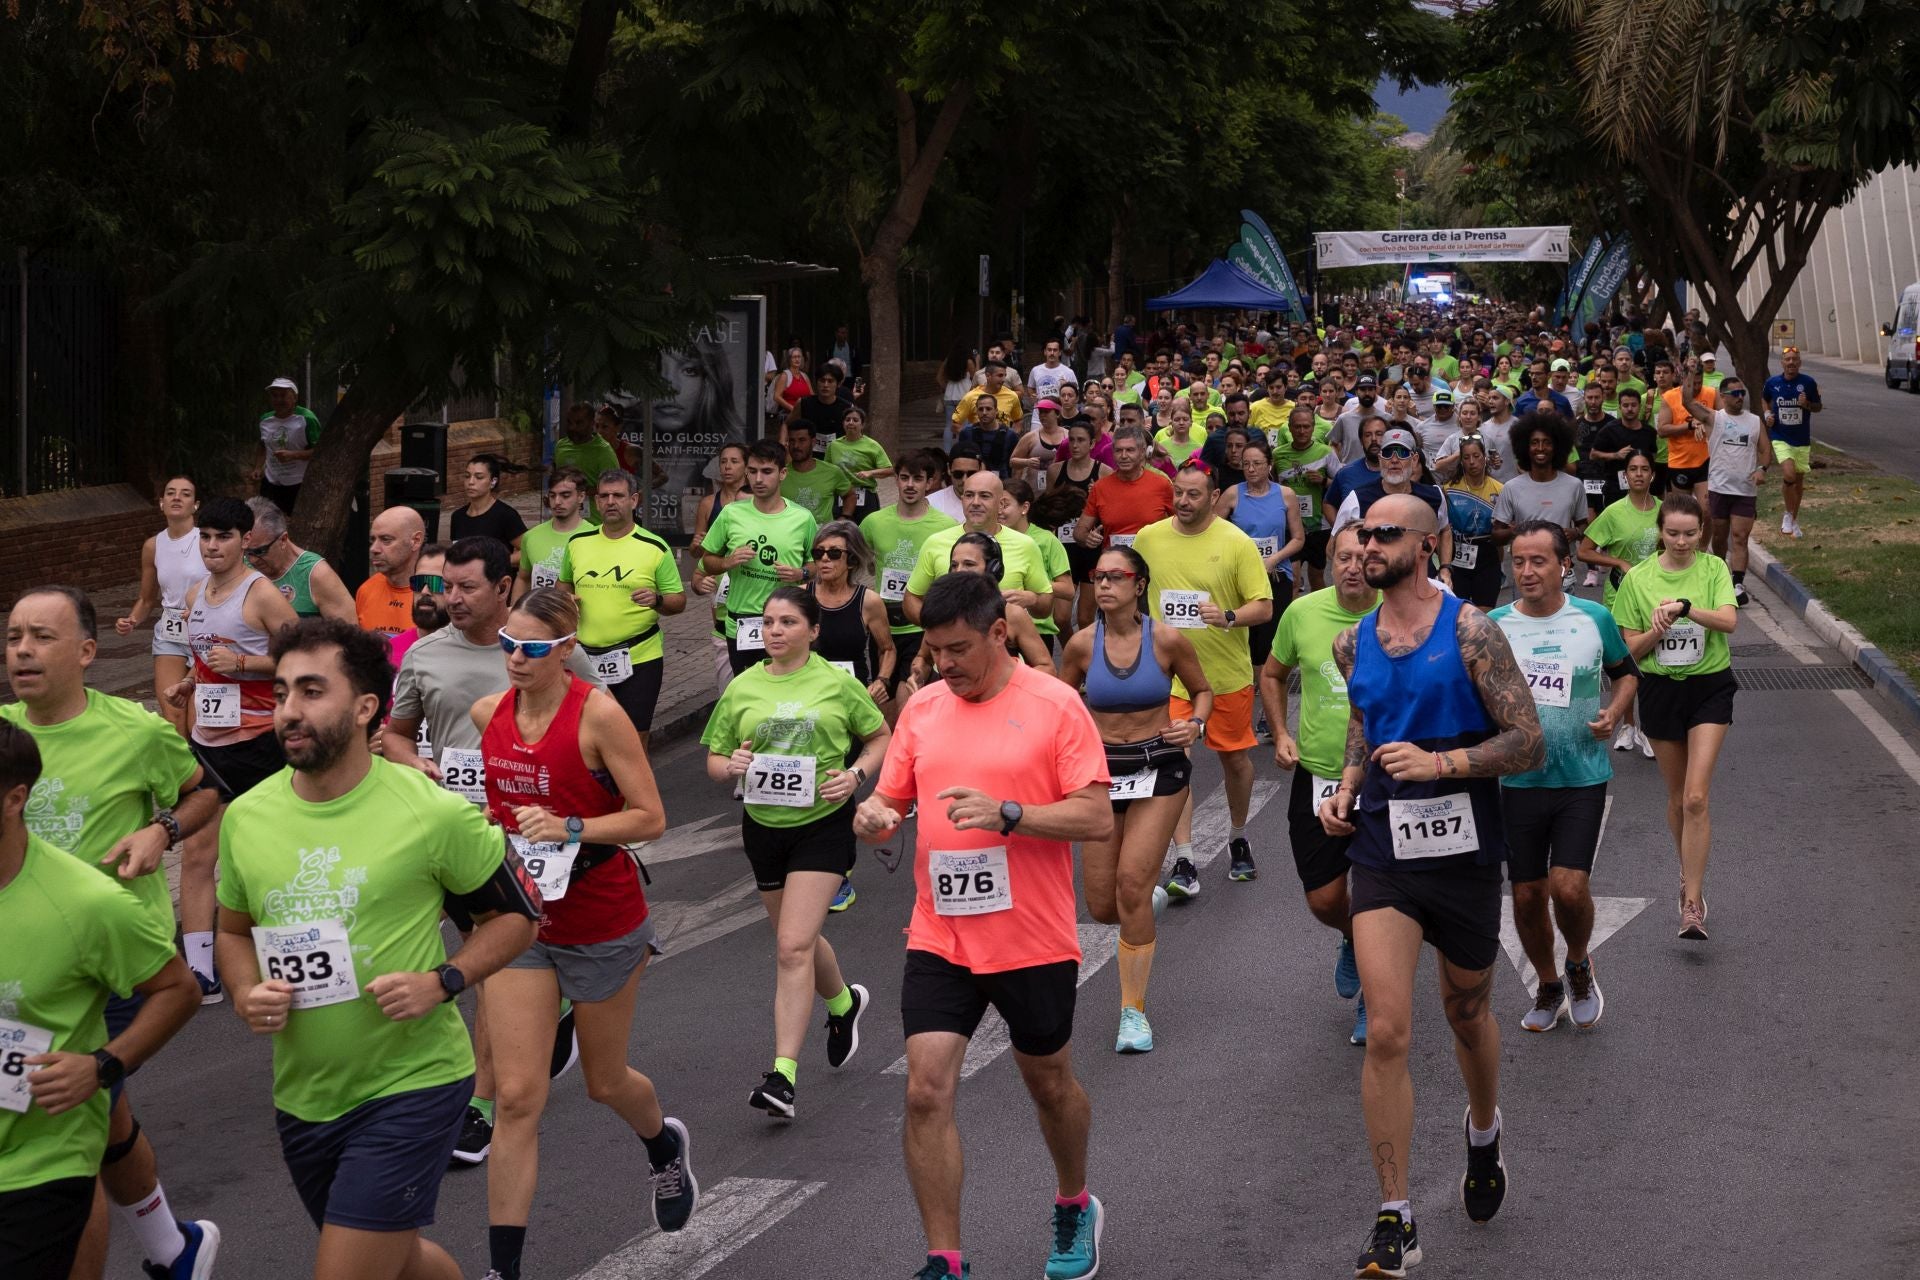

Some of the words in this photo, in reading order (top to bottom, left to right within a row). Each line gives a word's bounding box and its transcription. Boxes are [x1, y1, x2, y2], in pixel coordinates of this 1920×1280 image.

[1381, 233, 1428, 243] Carrera
[1431, 231, 1447, 241] de
[1450, 231, 1461, 241] la
[1465, 231, 1507, 240] Prensa
[1576, 238, 1602, 289] Fundació
[1591, 243, 1625, 295] Fundació
[1599, 258, 1629, 299] Unicaja
[616, 432, 673, 443] ABELO
[676, 432, 728, 443] GLOSSY
[657, 446, 717, 455] ANTI-FRIZZ
[761, 549, 777, 561] BM
[1165, 603, 1199, 617] 936
[166, 619, 182, 633] 21
[1658, 638, 1698, 651] 1071
[597, 662, 618, 675] 42
[1527, 673, 1564, 691] 744
[202, 698, 222, 714] 37
[498, 758, 536, 774] GENERALI
[496, 777, 539, 795] MÁLAGA
[755, 771, 802, 792] 782
[1398, 815, 1462, 840] 1187
[938, 871, 994, 896] 876
[264, 888, 342, 913] Carrera
[267, 950, 333, 984] 633
[0, 1048, 27, 1077] 8
